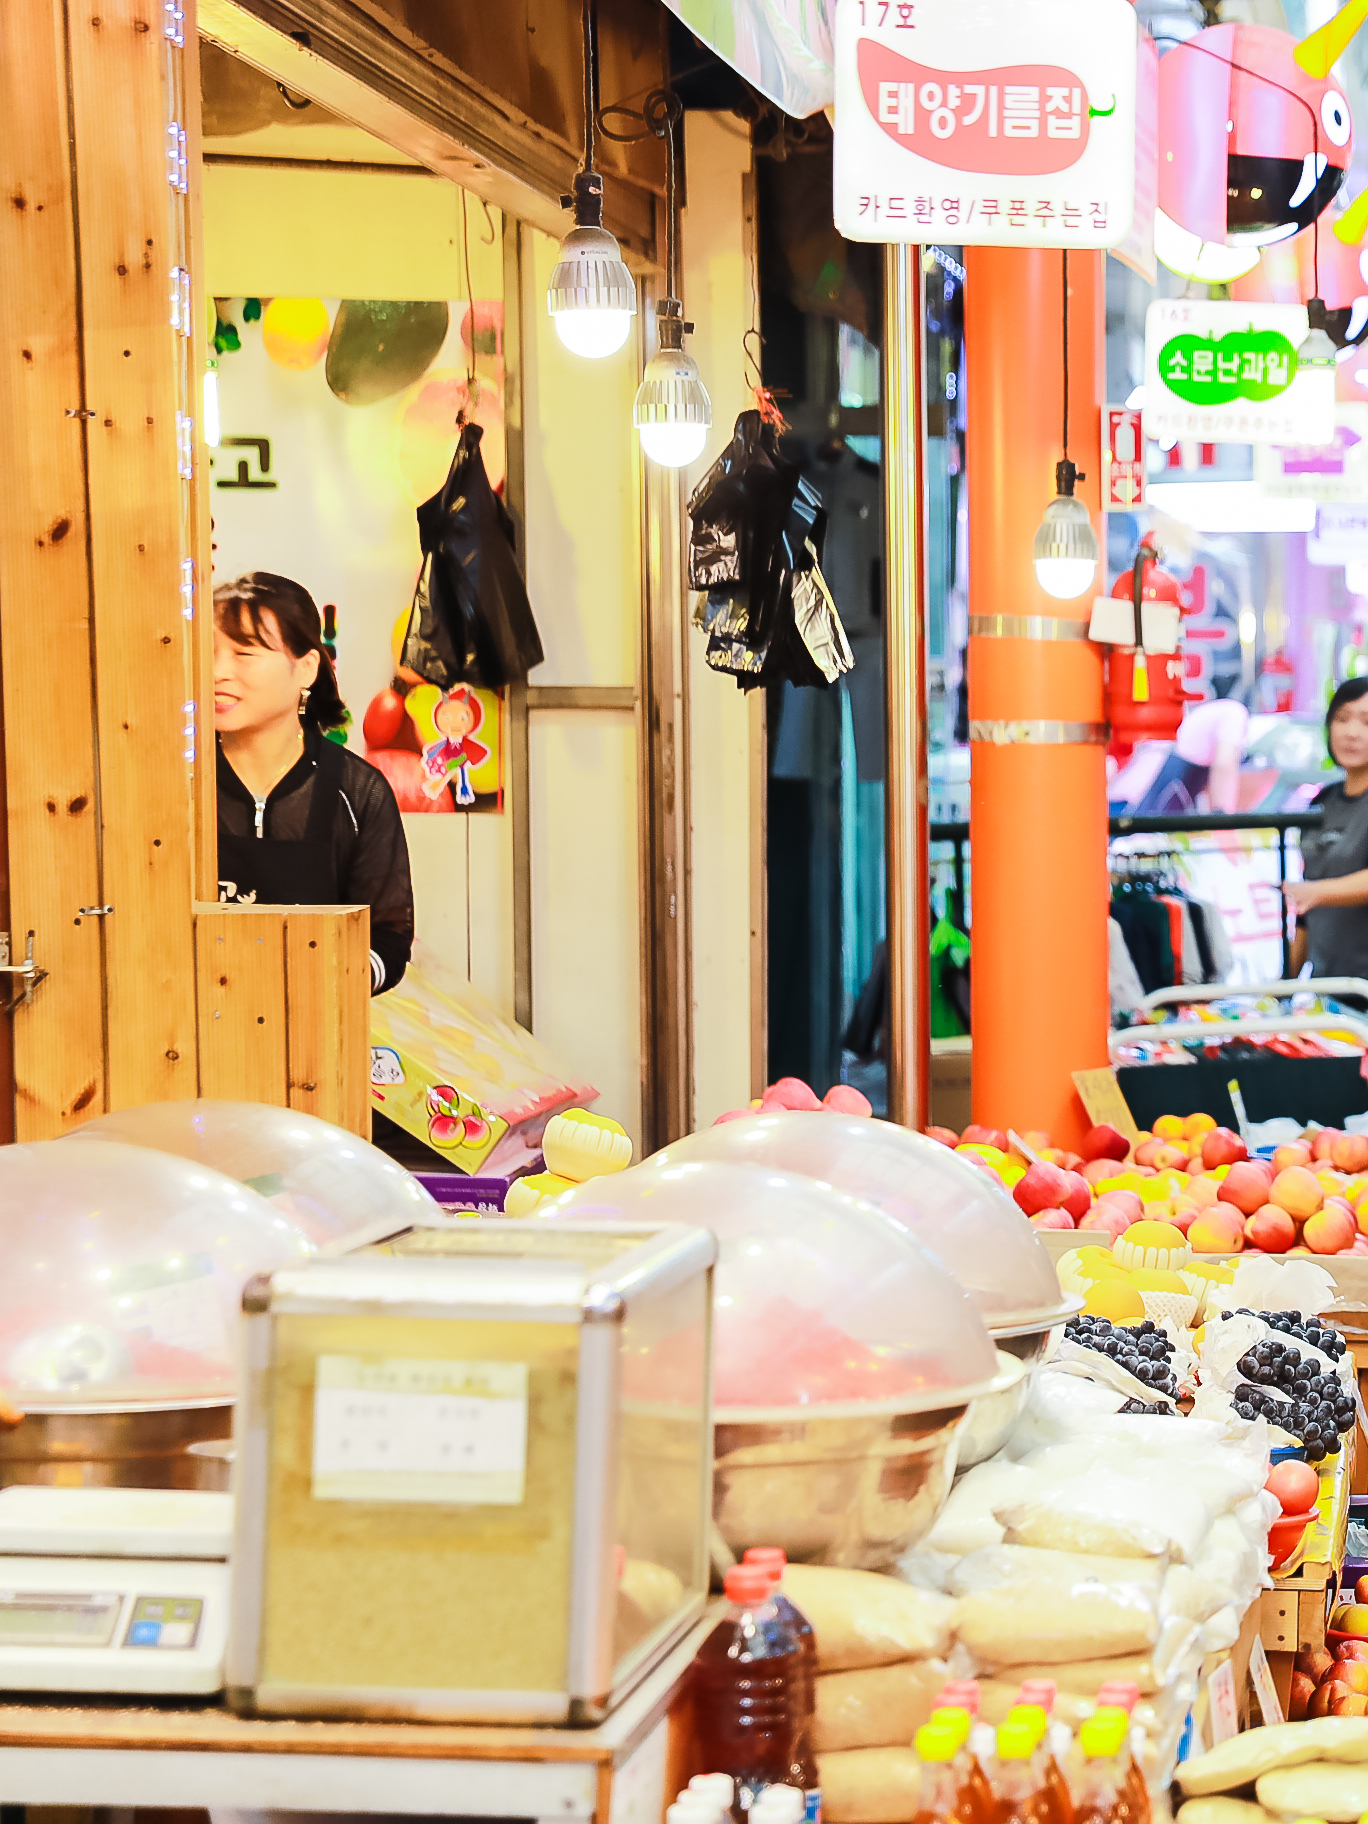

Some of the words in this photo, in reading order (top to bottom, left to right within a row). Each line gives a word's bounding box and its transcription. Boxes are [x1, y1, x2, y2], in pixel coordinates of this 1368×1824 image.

[858, 0, 916, 29] 17호
[877, 82, 1083, 140] 태양기름집
[857, 194, 1109, 229] 카드환영/쿠폰주는집
[1166, 349, 1288, 386] 소문난과일
